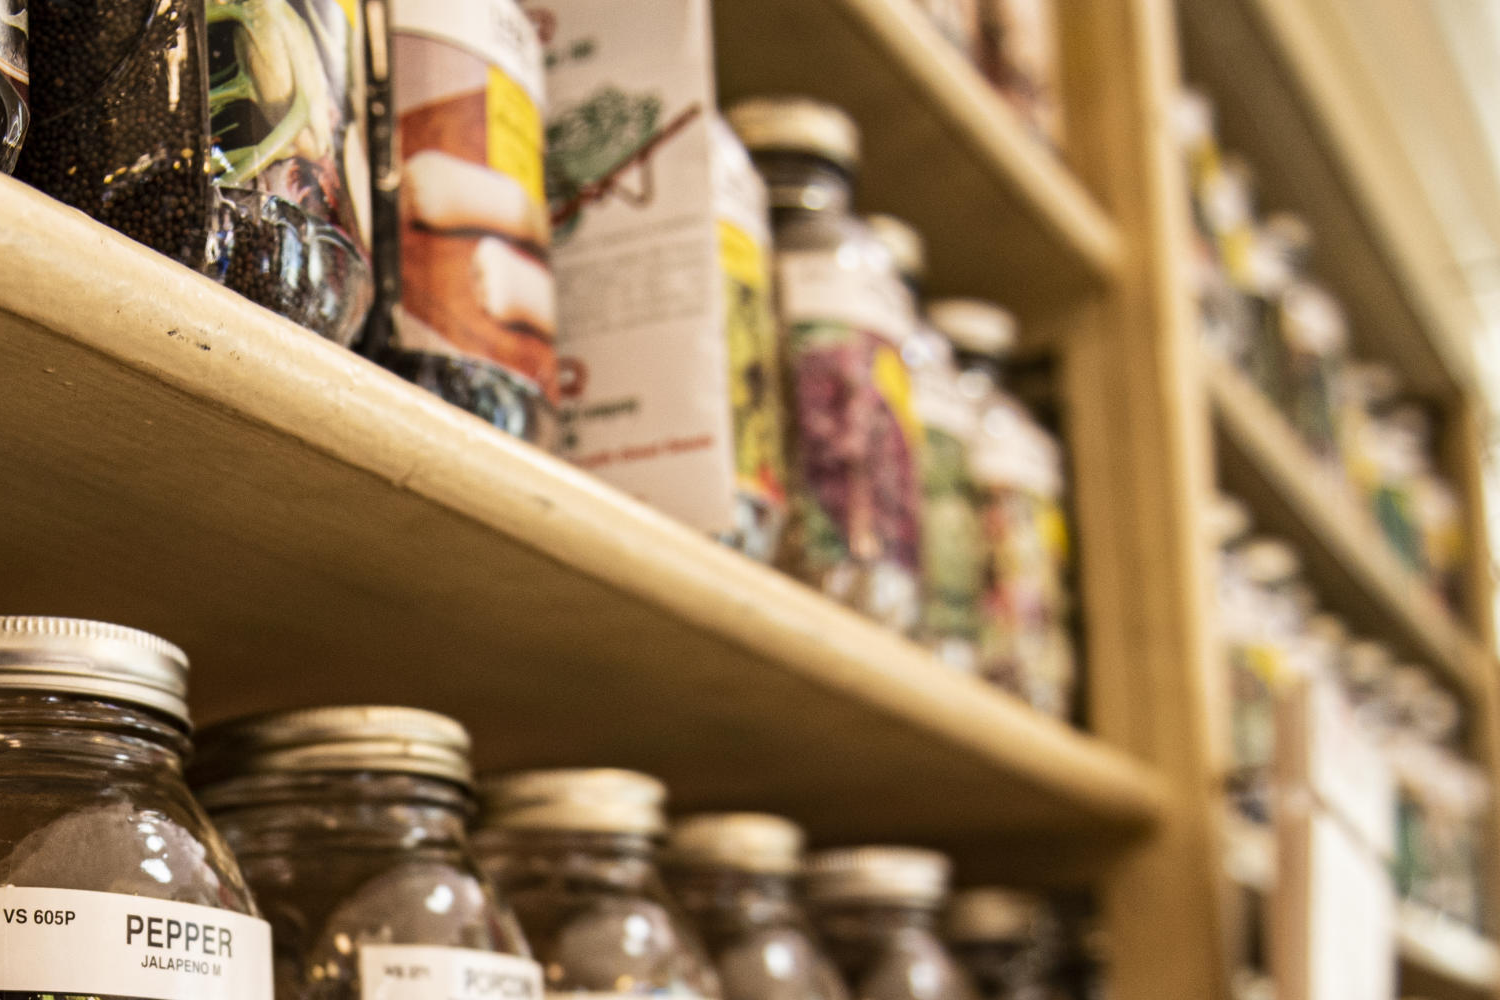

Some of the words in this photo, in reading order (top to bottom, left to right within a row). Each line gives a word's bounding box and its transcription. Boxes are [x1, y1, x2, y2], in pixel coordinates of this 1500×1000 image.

[3, 908, 28, 924] VS
[33, 910, 76, 926] 605P
[126, 913, 233, 959] PEPPER
[141, 954, 209, 976] JALAPENO
